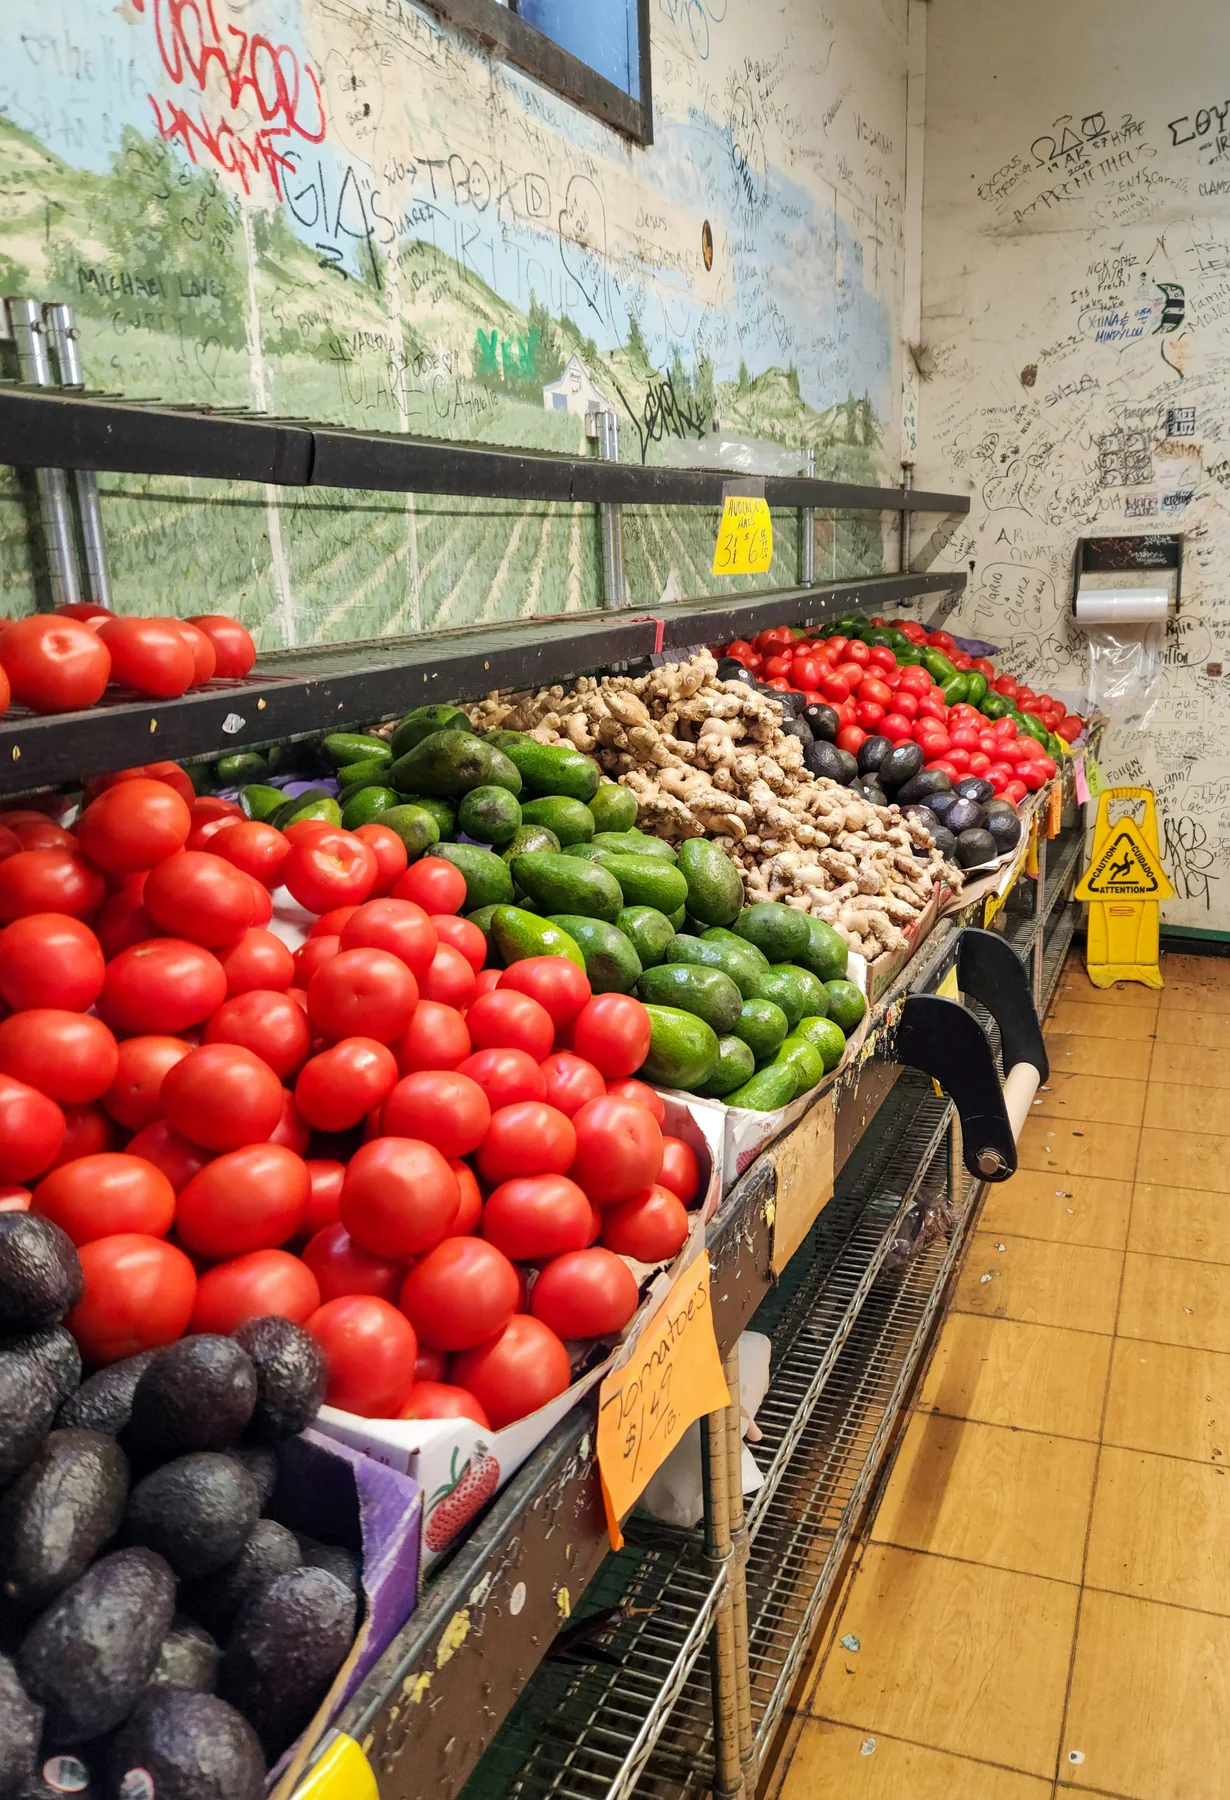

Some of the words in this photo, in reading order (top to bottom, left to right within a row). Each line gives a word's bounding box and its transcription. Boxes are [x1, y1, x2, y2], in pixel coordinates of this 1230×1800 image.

[635, 206, 668, 231] Jesus
[78, 267, 168, 299] MICHAEL
[1165, 619, 1194, 641] Rylie
[1092, 845, 1118, 878] CAUTION
[1131, 845, 1155, 878] CUIDADO
[1100, 886, 1146, 894] ATTENTION
[601, 1281, 707, 1430] Tomatoe's
